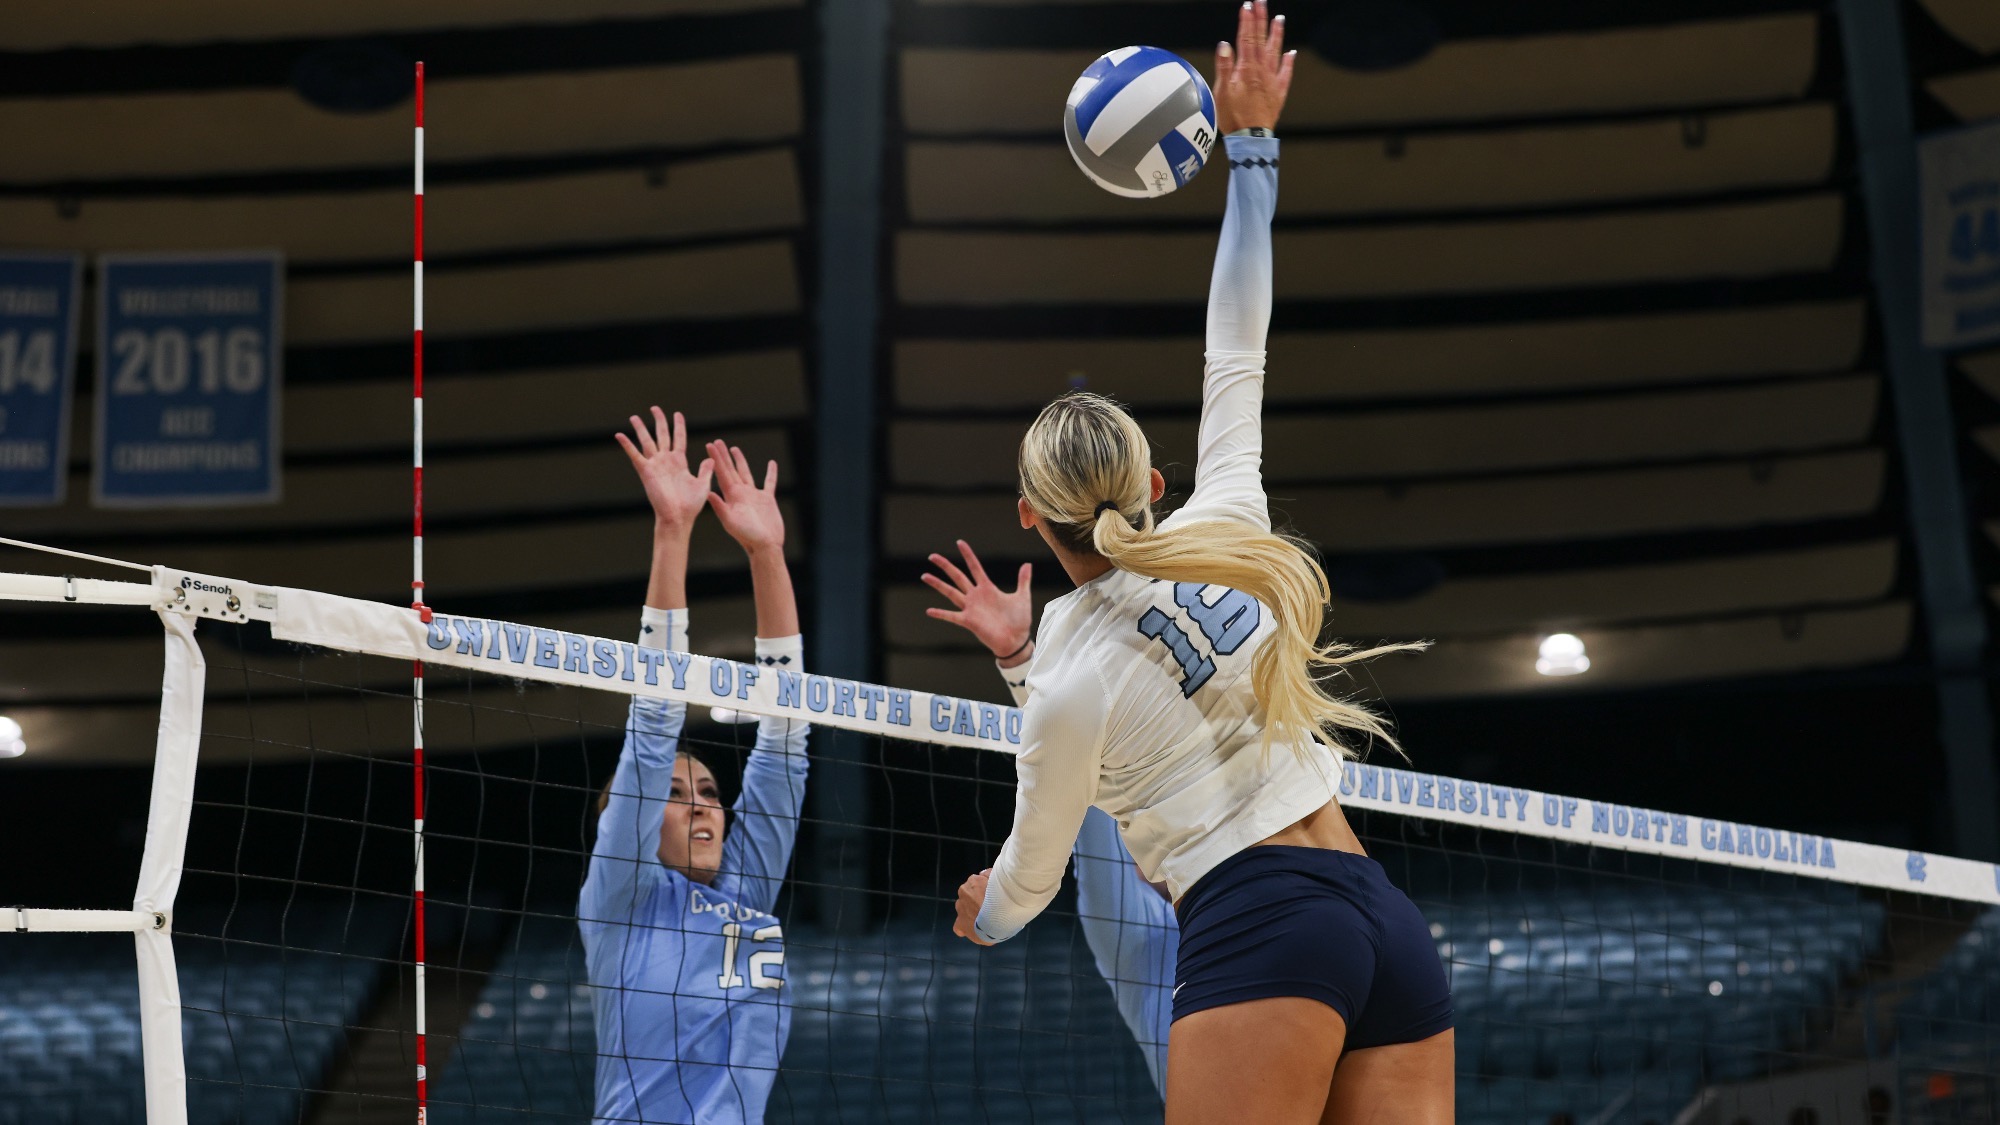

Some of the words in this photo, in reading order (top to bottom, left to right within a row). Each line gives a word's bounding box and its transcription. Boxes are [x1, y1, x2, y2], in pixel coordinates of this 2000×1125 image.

[113, 328, 263, 395] 2016
[193, 580, 233, 595] Senoh
[427, 616, 690, 690] UNIVERSITY
[710, 658, 760, 700] OF
[777, 669, 912, 727] NORTH
[1340, 762, 1530, 821] UNIVERSITY
[1543, 794, 1579, 828] OF
[1592, 801, 1689, 847] NORTH
[1701, 818, 1836, 869] CAROLINA
[717, 920, 786, 990] 12
